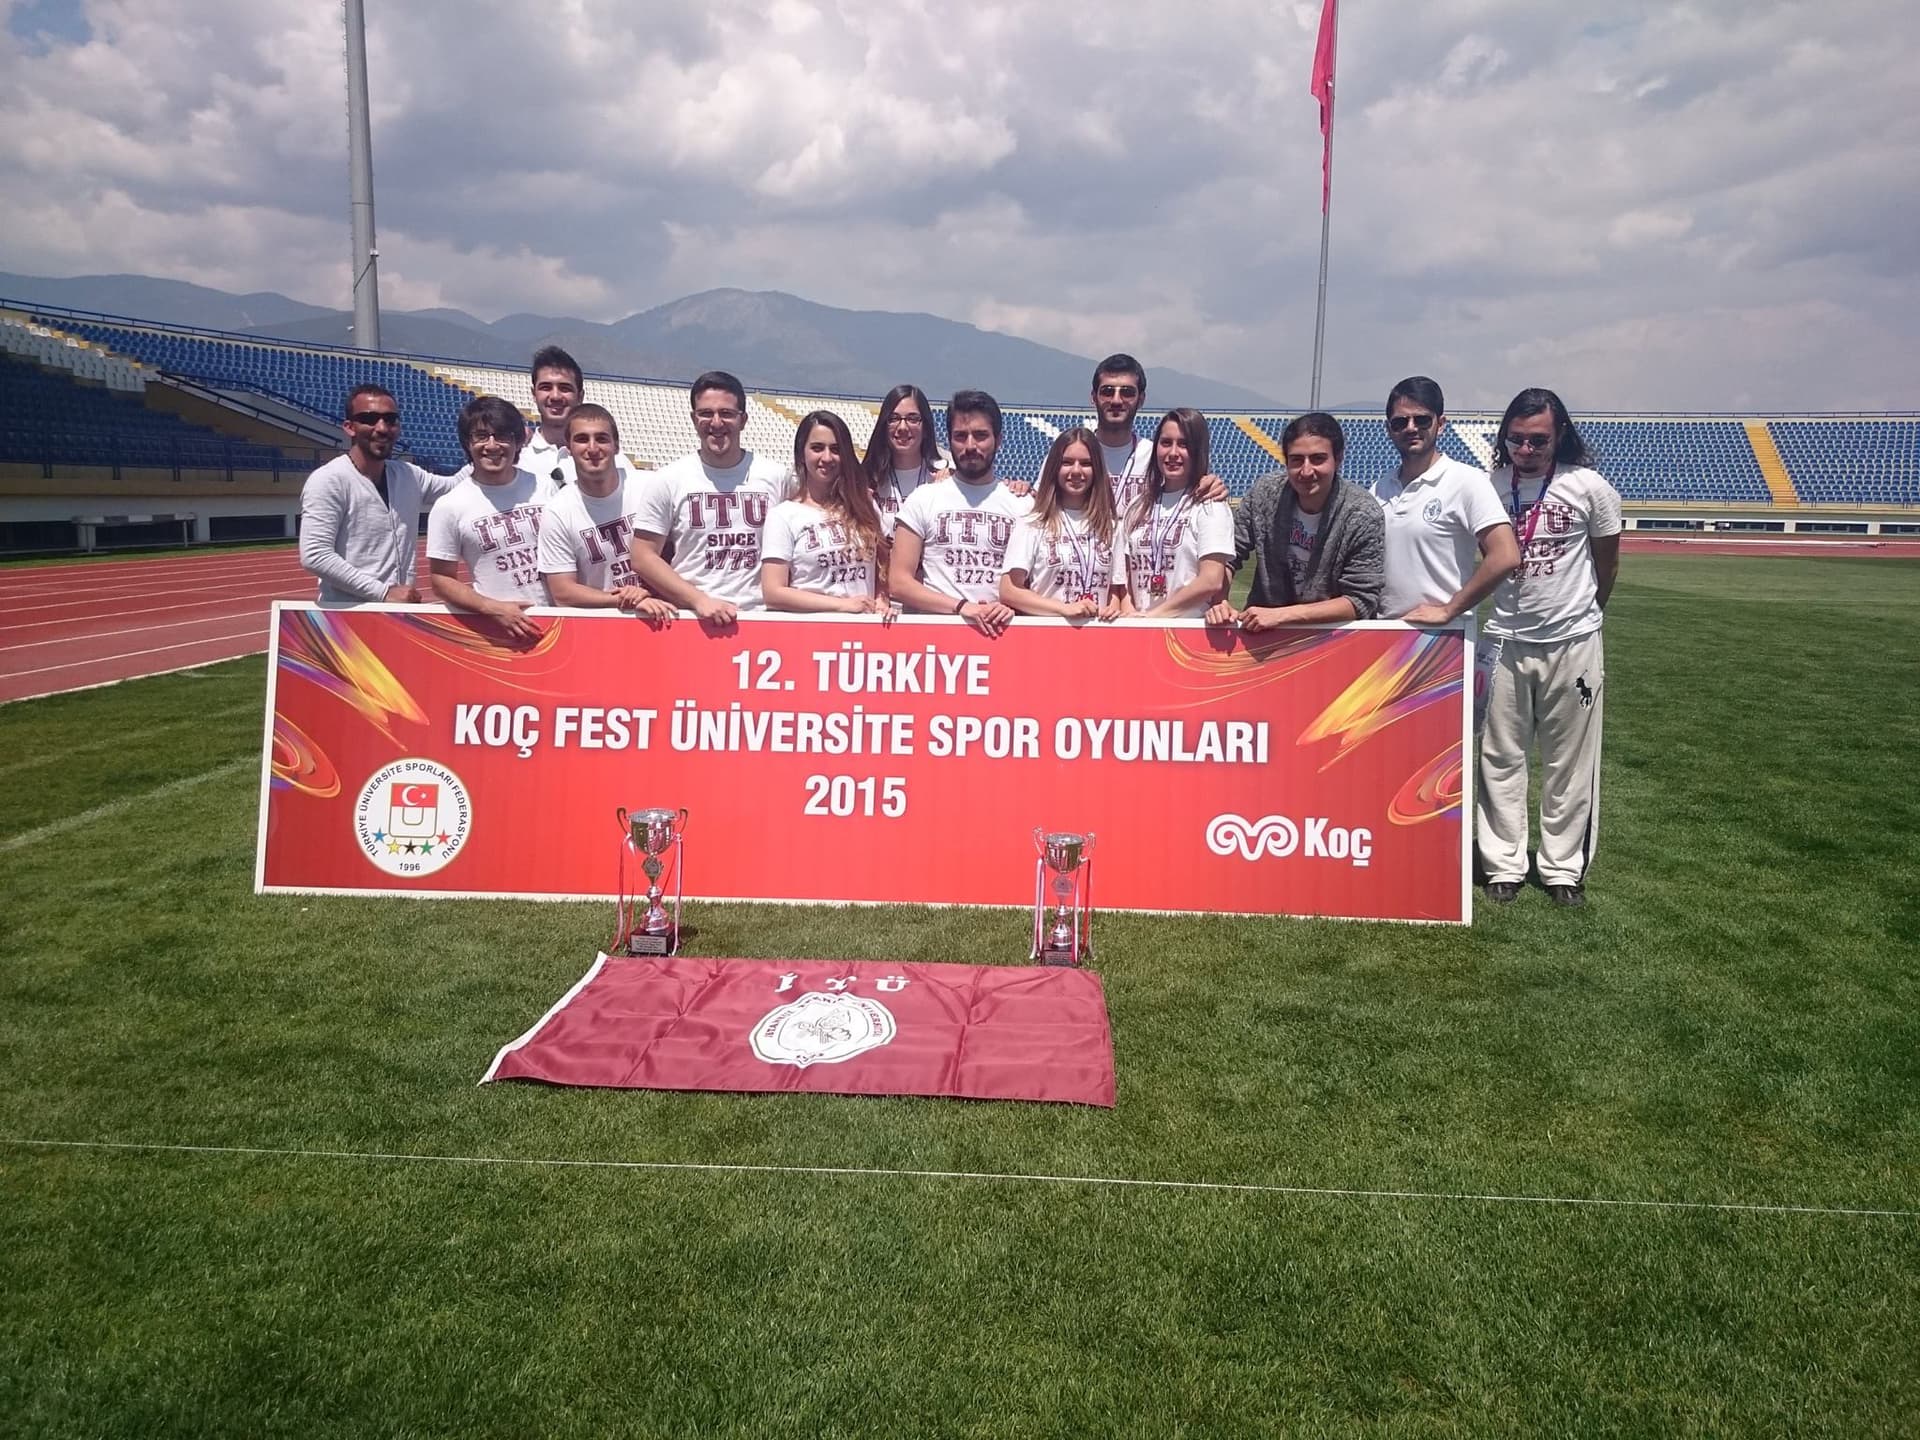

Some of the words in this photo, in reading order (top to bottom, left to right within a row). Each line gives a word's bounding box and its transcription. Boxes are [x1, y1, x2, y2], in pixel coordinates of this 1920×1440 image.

[687, 492, 769, 529] ITU
[707, 532, 756, 547] SINCE
[935, 510, 1016, 551] ITU
[704, 548, 758, 571] 1773
[831, 566, 866, 583] 1773
[945, 549, 1004, 569] SINCE
[955, 568, 994, 584] 1773
[733, 650, 795, 691] 12.
[812, 641, 990, 696] TÜRKİYE
[454, 704, 540, 758] KOÇ
[554, 707, 658, 750] FEST
[671, 699, 914, 755] ÜNİVERSİTE
[928, 714, 1040, 758] SPOR
[1054, 717, 1269, 763] OYUNLARI
[360, 764, 403, 811] ÜNİVERSİTE
[405, 762, 454, 786] SPORLARI
[804, 774, 907, 818] 2015
[359, 815, 379, 857] TÜRKİYE
[441, 784, 468, 859] FEDERASYONU
[399, 862, 421, 871] 1996
